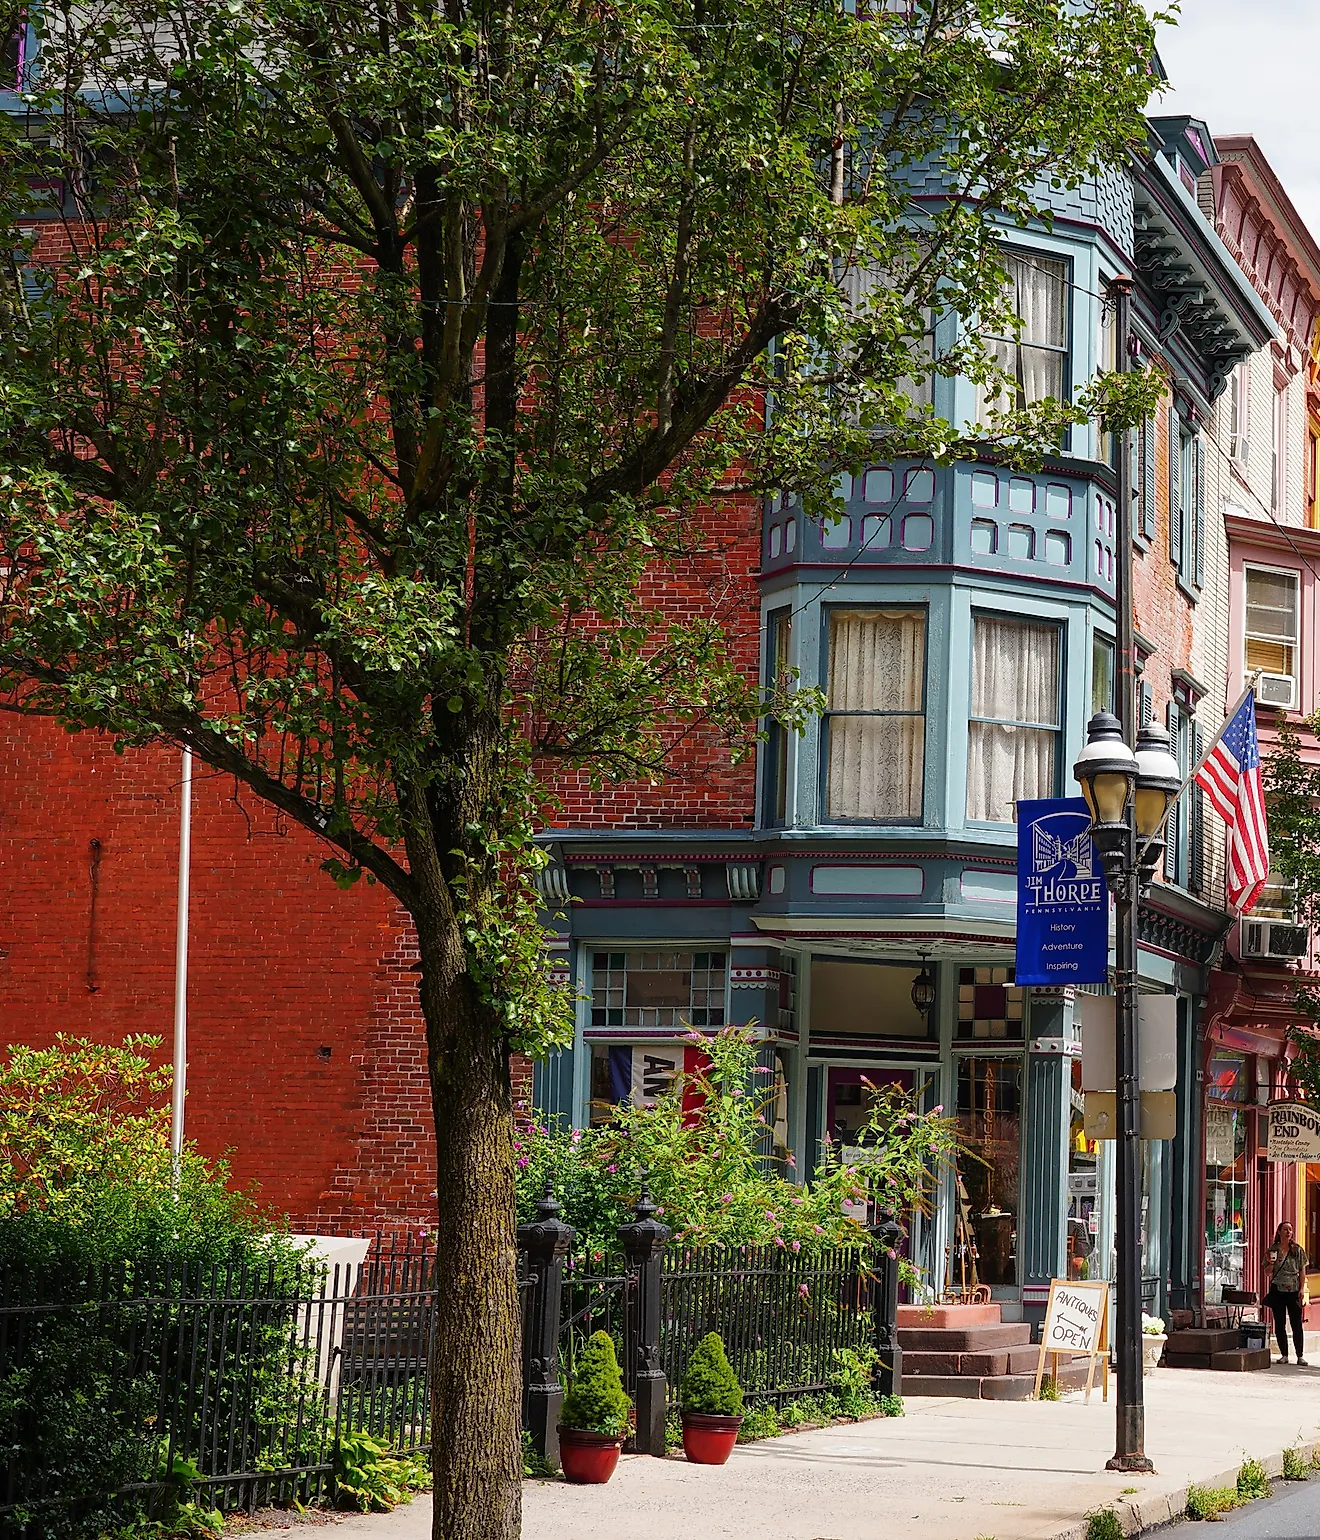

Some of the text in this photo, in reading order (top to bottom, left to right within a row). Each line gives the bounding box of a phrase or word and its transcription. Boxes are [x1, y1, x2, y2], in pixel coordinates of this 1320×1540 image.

[1025, 876, 1042, 888] JIM
[1030, 877, 1101, 906] THORPE
[1025, 906, 1101, 914] PENNSYLVANIA
[1050, 924, 1076, 932] History
[1042, 943, 1083, 951] Adventure
[1046, 962, 1078, 971] Inspiring
[983, 1068, 994, 1156] ANTIQUES
[1274, 1126, 1299, 1137] END
[1056, 1291, 1098, 1322] ANTIQUES
[1053, 1326, 1091, 1349] OPEN
